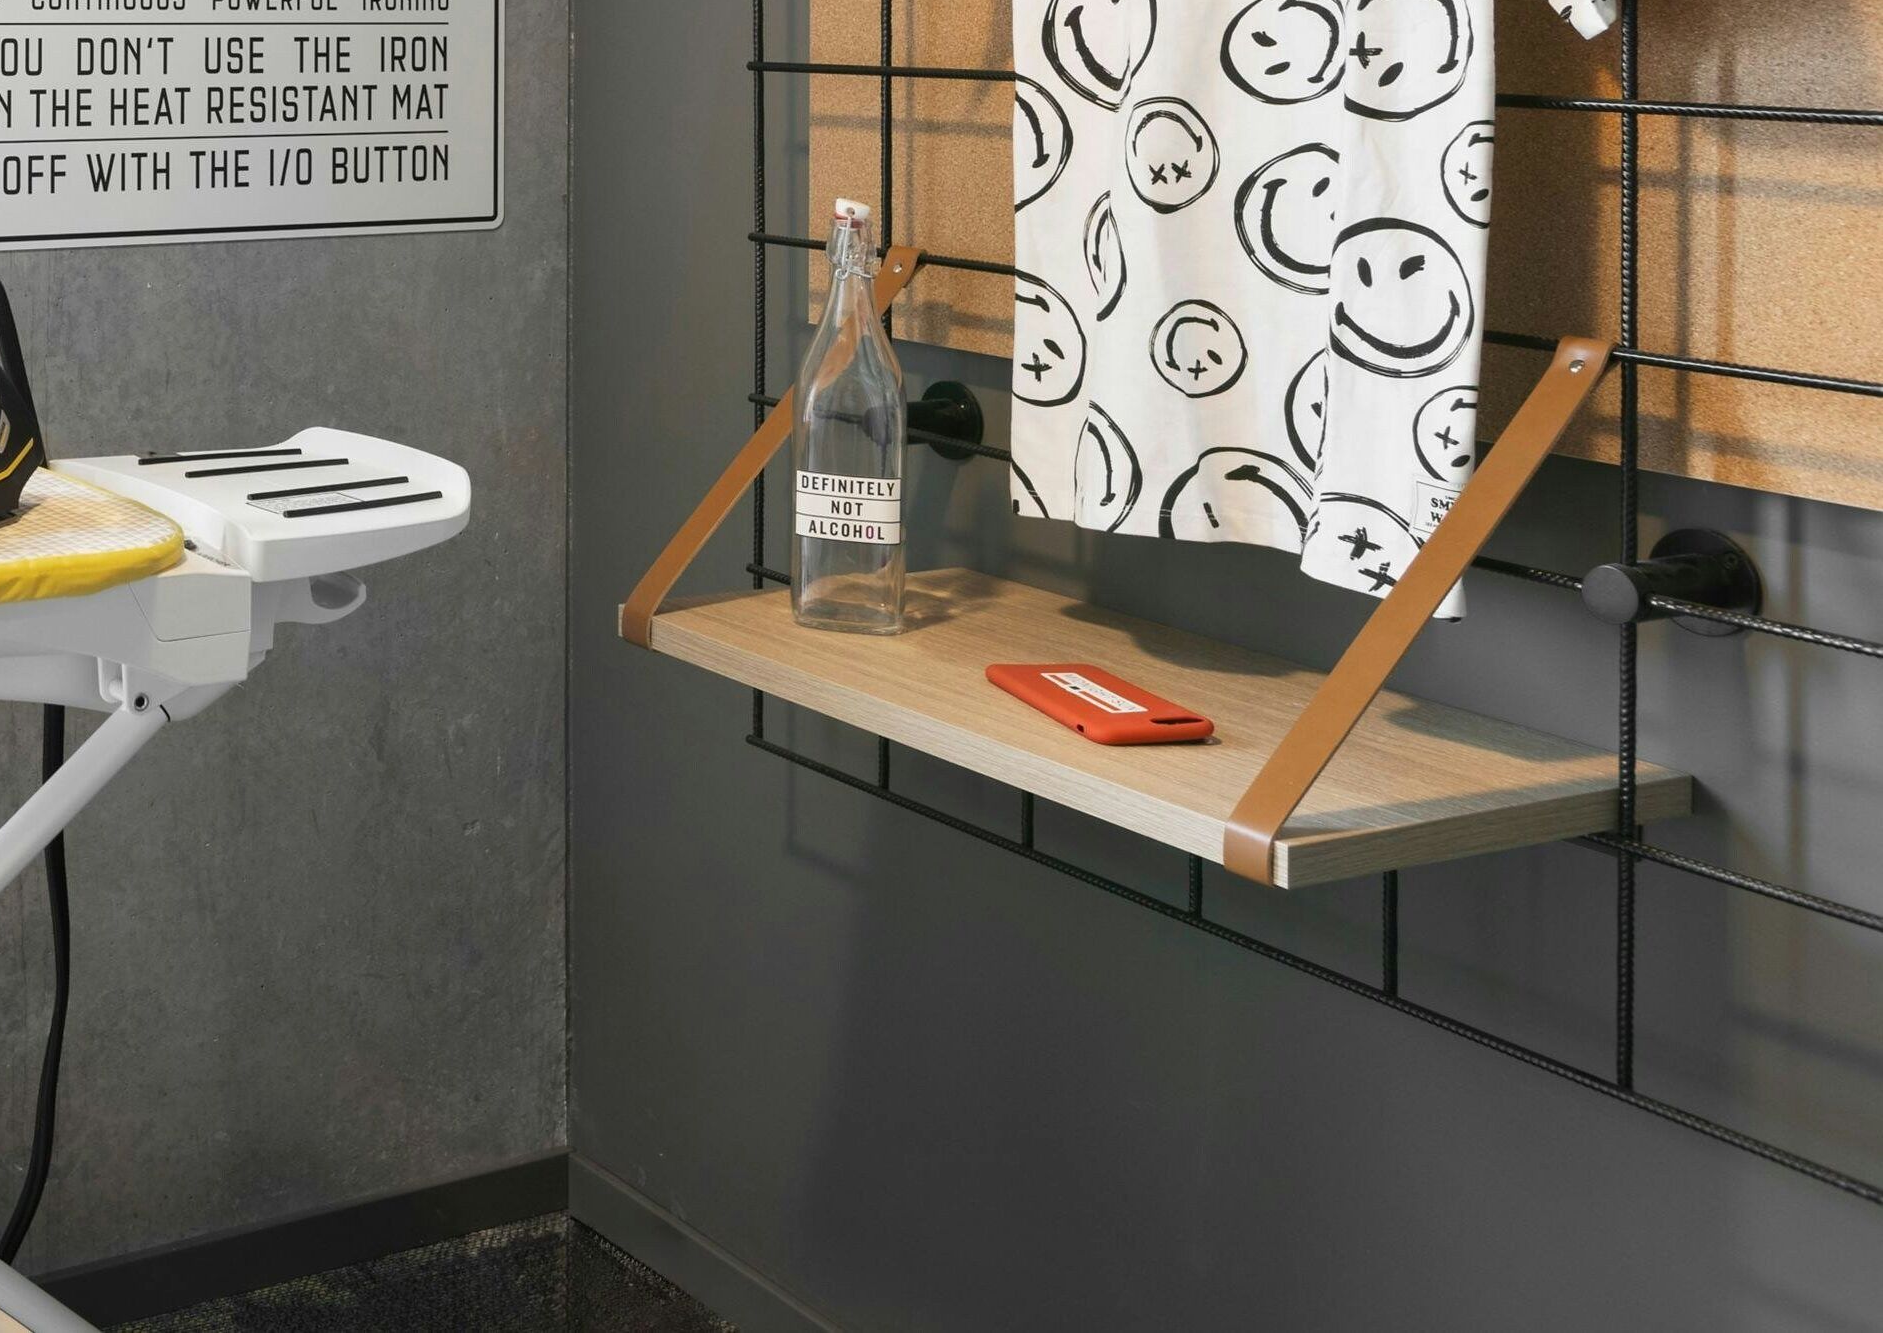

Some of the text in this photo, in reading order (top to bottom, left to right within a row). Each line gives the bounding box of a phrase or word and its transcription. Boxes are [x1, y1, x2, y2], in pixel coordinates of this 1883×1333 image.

[78, 38, 173, 75] DON'T
[205, 37, 264, 74] USE
[294, 37, 350, 73] THE
[381, 36, 447, 72] IRON
[30, 89, 91, 127] THE
[111, 88, 190, 125] HEAT
[207, 85, 377, 123] RESISTANT
[393, 84, 448, 120] MAT
[4, 155, 66, 195] OFF
[87, 152, 169, 192] WITH
[190, 150, 249, 188] THE
[270, 148, 312, 186] I/O
[332, 145, 448, 184] BUTTON
[801, 474, 895, 497] DEFINITELY
[831, 500, 863, 516] NOT
[808, 519, 885, 541] ALCOHOL
